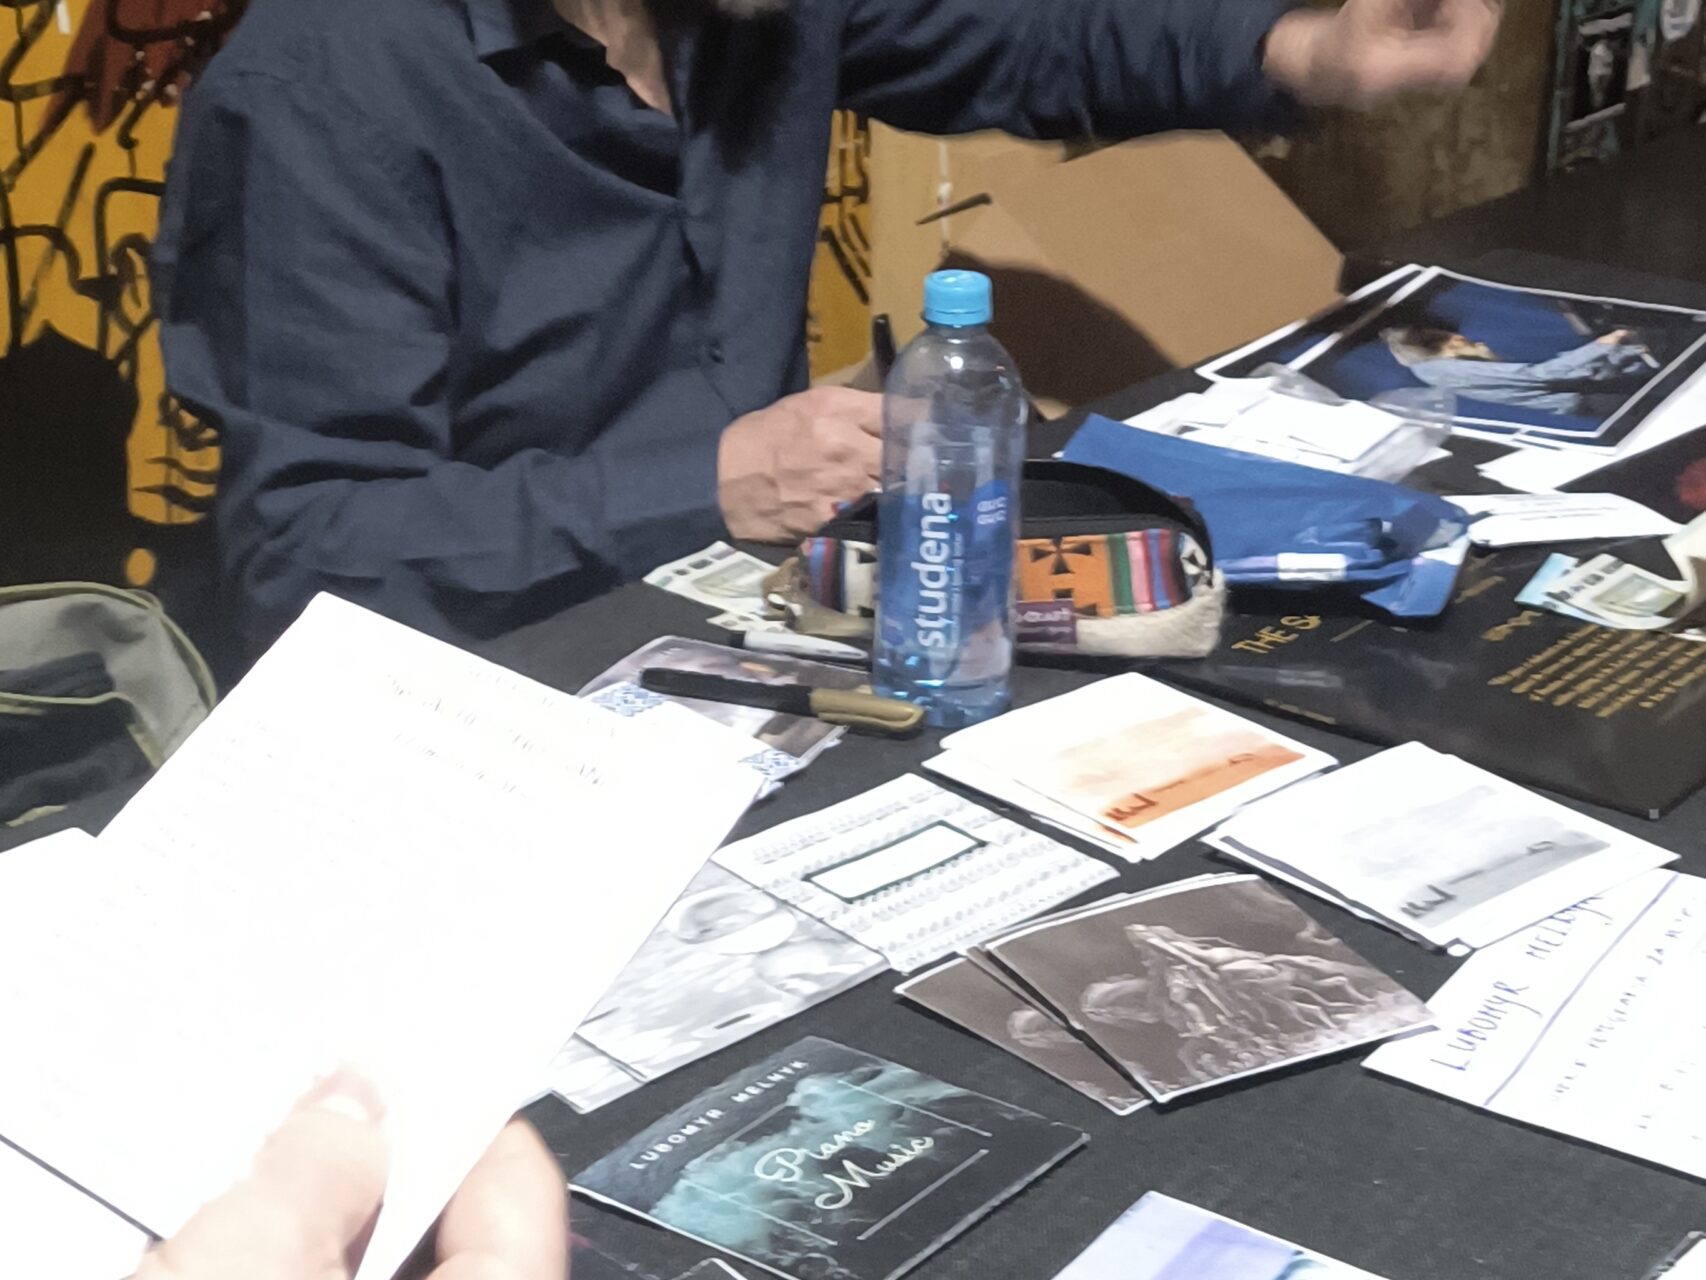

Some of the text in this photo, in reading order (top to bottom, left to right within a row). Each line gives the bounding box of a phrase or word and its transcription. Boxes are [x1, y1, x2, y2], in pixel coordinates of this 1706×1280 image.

[910, 492, 952, 649] studena
[1231, 625, 1299, 654] THE
[753, 1118, 876, 1182] Piano
[814, 1135, 935, 1211] Music
